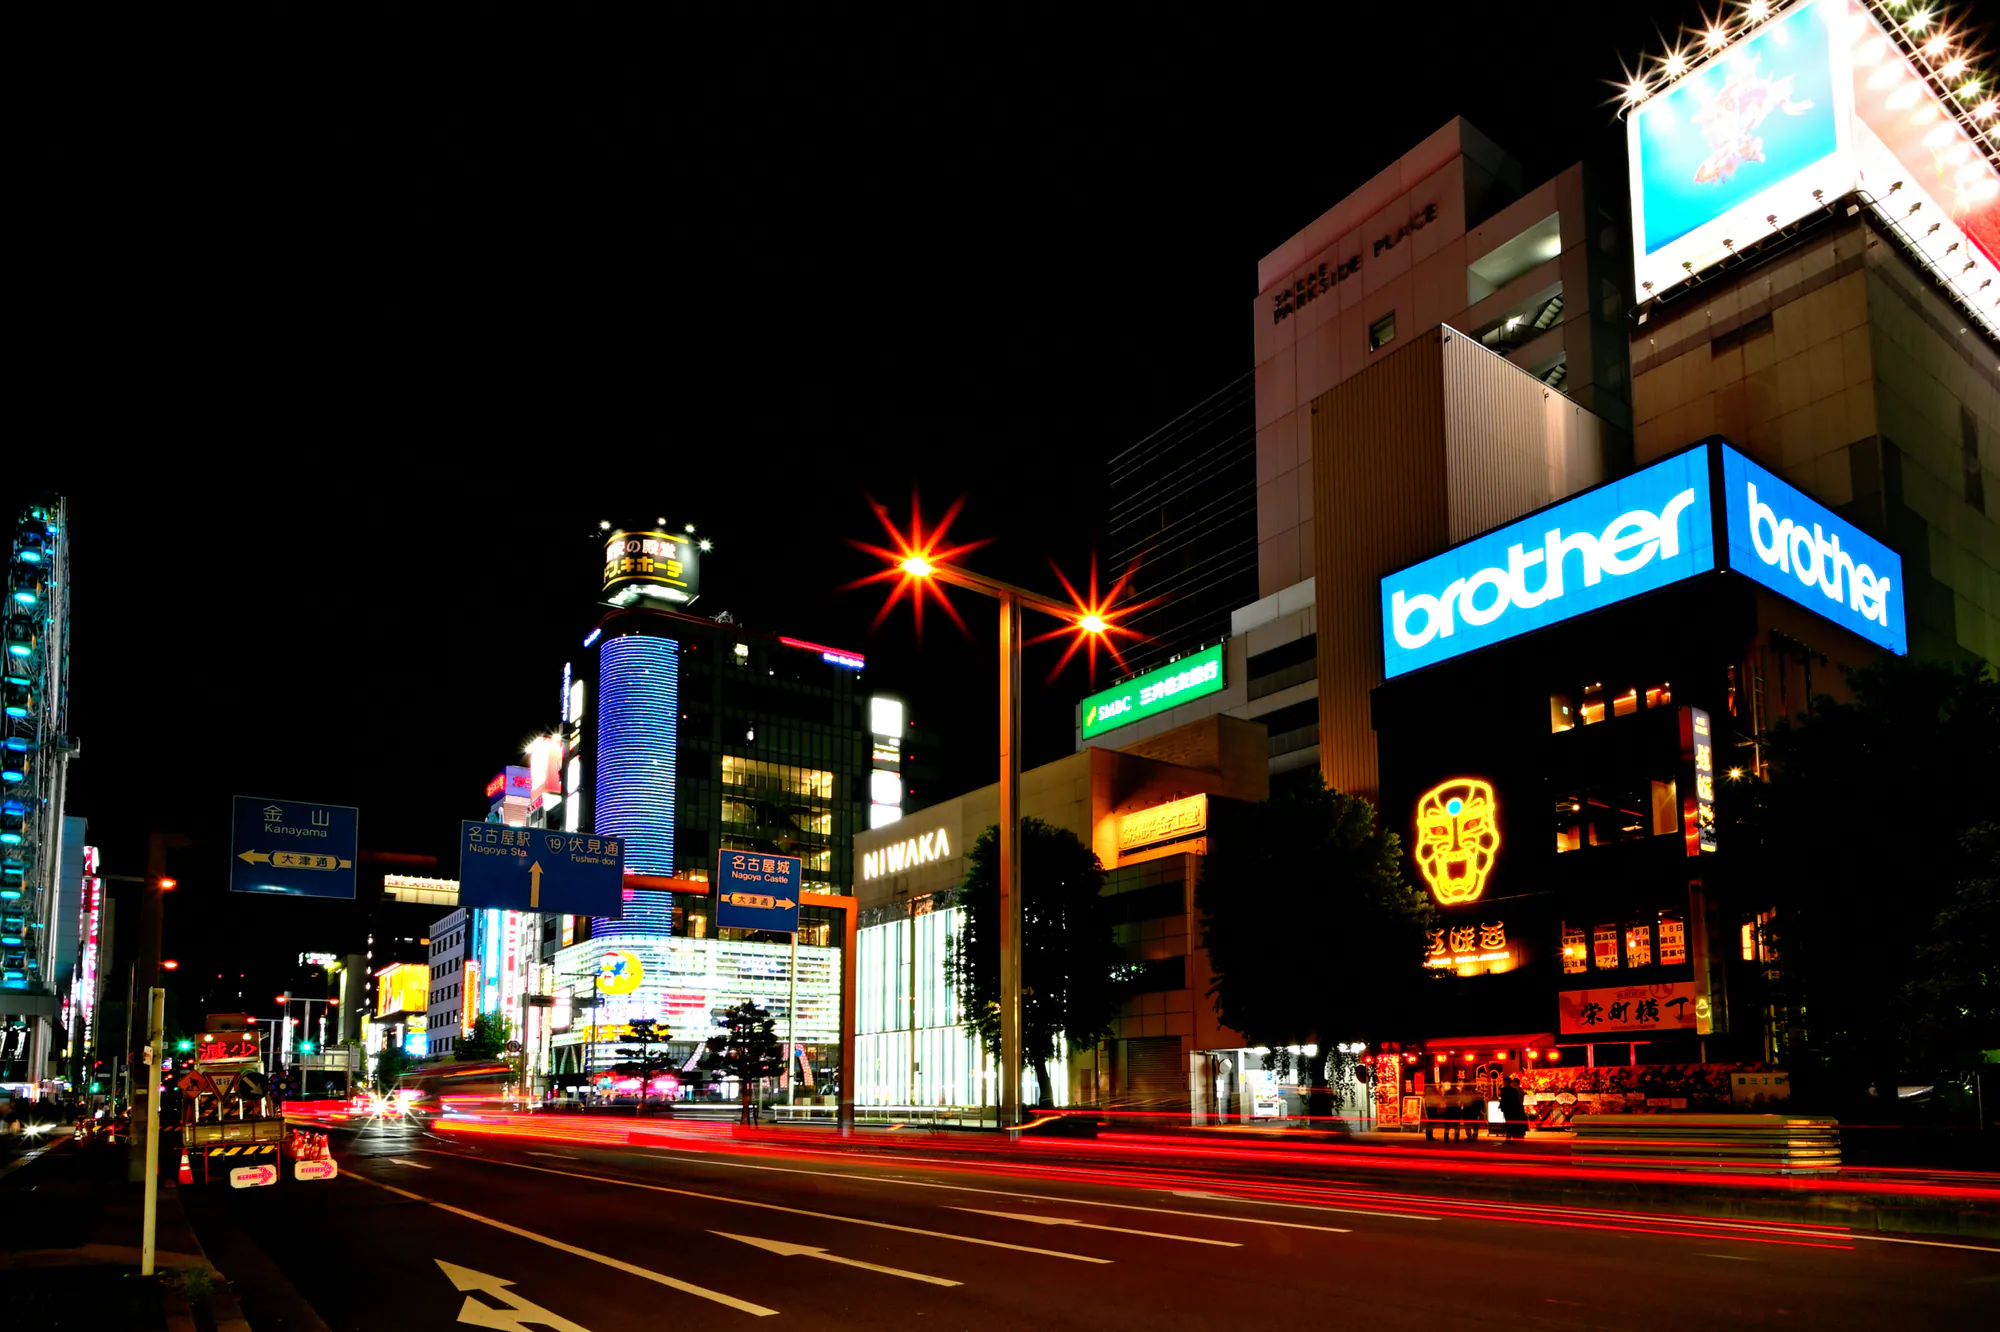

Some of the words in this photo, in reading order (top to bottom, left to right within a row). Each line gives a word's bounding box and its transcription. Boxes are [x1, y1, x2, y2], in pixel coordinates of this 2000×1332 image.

[1274, 254, 1362, 324] PARKSIDE
[1373, 202, 1438, 257] PLACE
[1275, 263, 1328, 307] SAKAE
[1747, 481, 1891, 627] brother
[1391, 487, 1695, 650] brother
[1098, 695, 1133, 720] SMBC
[263, 804, 330, 826] 金山
[264, 823, 328, 838] Kanayama
[468, 826, 531, 847] 名古屋駅
[469, 843, 508, 856] Nagoya
[510, 847, 529, 857] Sta.
[549, 837, 562, 850] 19
[568, 837, 619, 857] 伏見通
[281, 854, 328, 868] 大津通
[863, 828, 950, 881] NIWAKA
[731, 855, 791, 875] 名古屋城
[731, 870, 762, 882] Nagoya
[764, 873, 789, 884] Castle
[737, 896, 769, 906] 大津通
[1634, 928, 1649, 937] 9月
[1563, 958, 1587, 969] 正社員
[1627, 952, 1650, 960] バイト
[1661, 949, 1685, 958] 募集中
[1580, 996, 1690, 1026] 栄町横丁
[198, 1040, 258, 1059] 減少
[215, 1077, 231, 1086] 徐行
